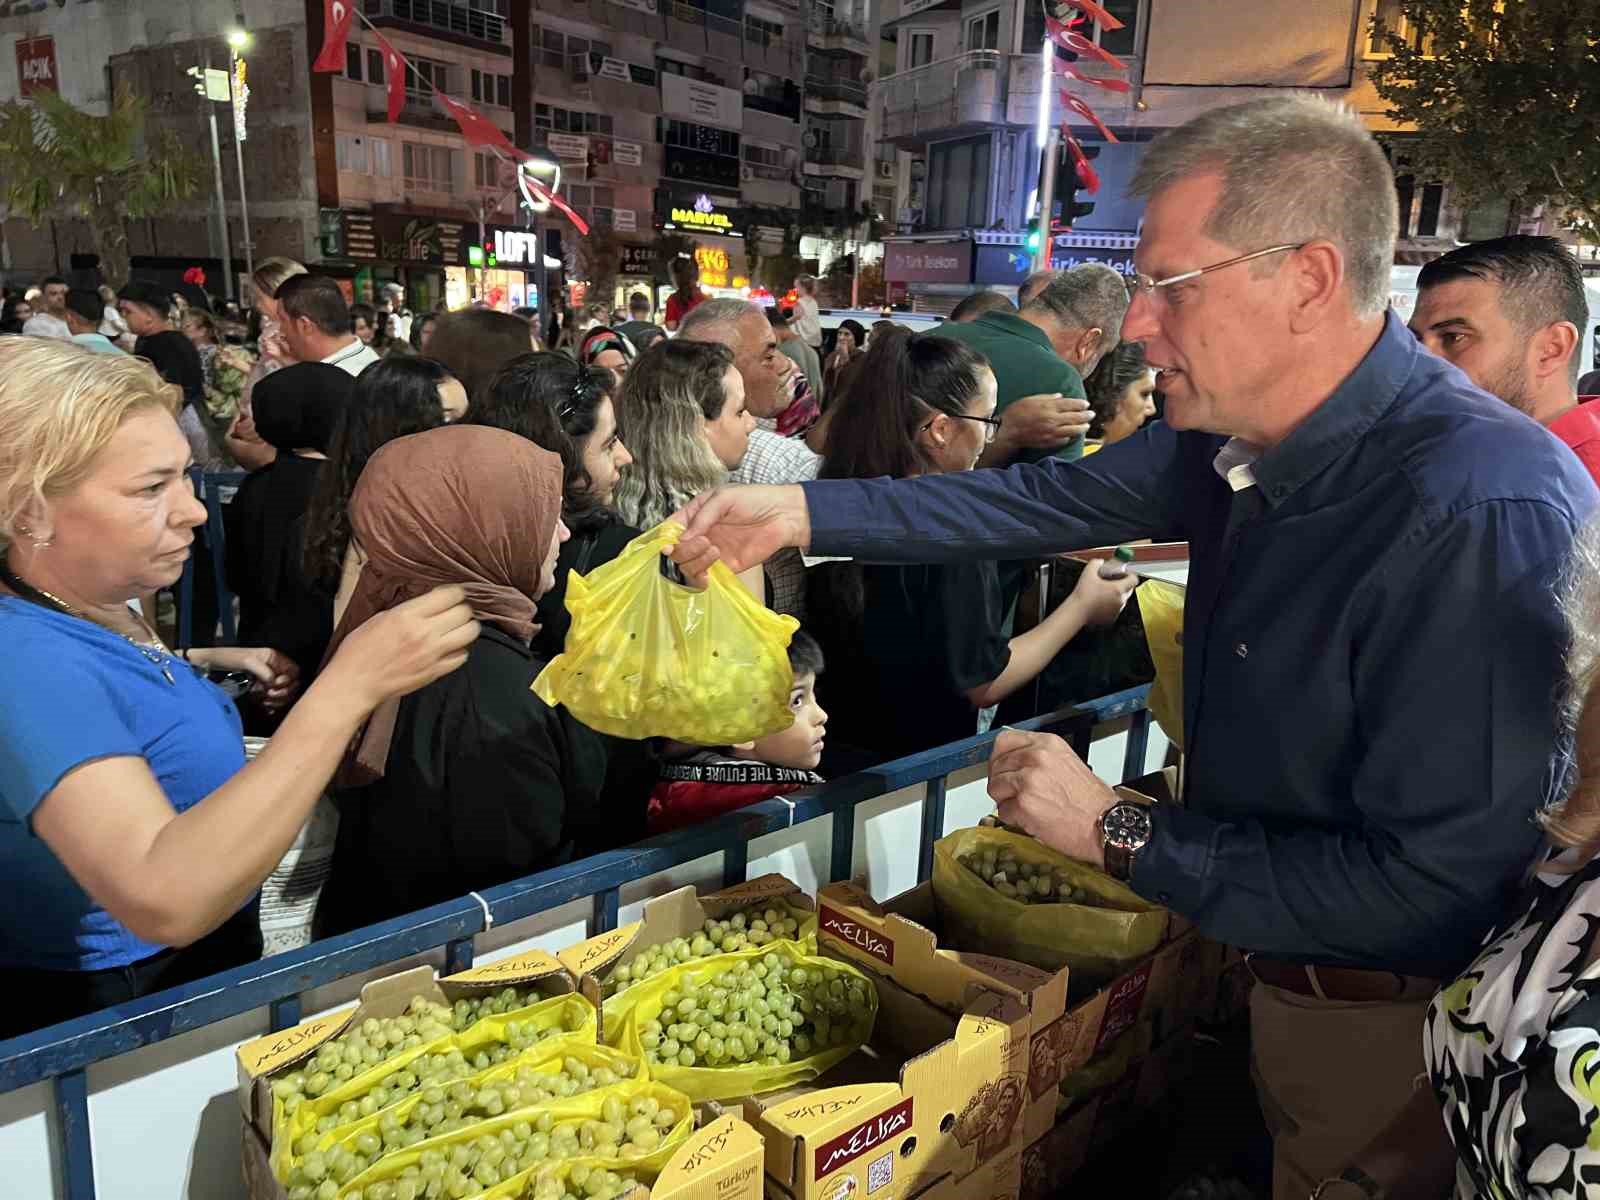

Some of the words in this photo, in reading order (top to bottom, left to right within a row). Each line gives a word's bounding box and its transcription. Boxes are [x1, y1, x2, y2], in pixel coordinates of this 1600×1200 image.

[671, 207, 733, 228] MARVEL
[495, 230, 537, 265] LOFT
[1048, 256, 1081, 272] ürk
[706, 766, 747, 782] FUTURE
[749, 767, 773, 782] THE
[776, 767, 807, 783] MAKE
